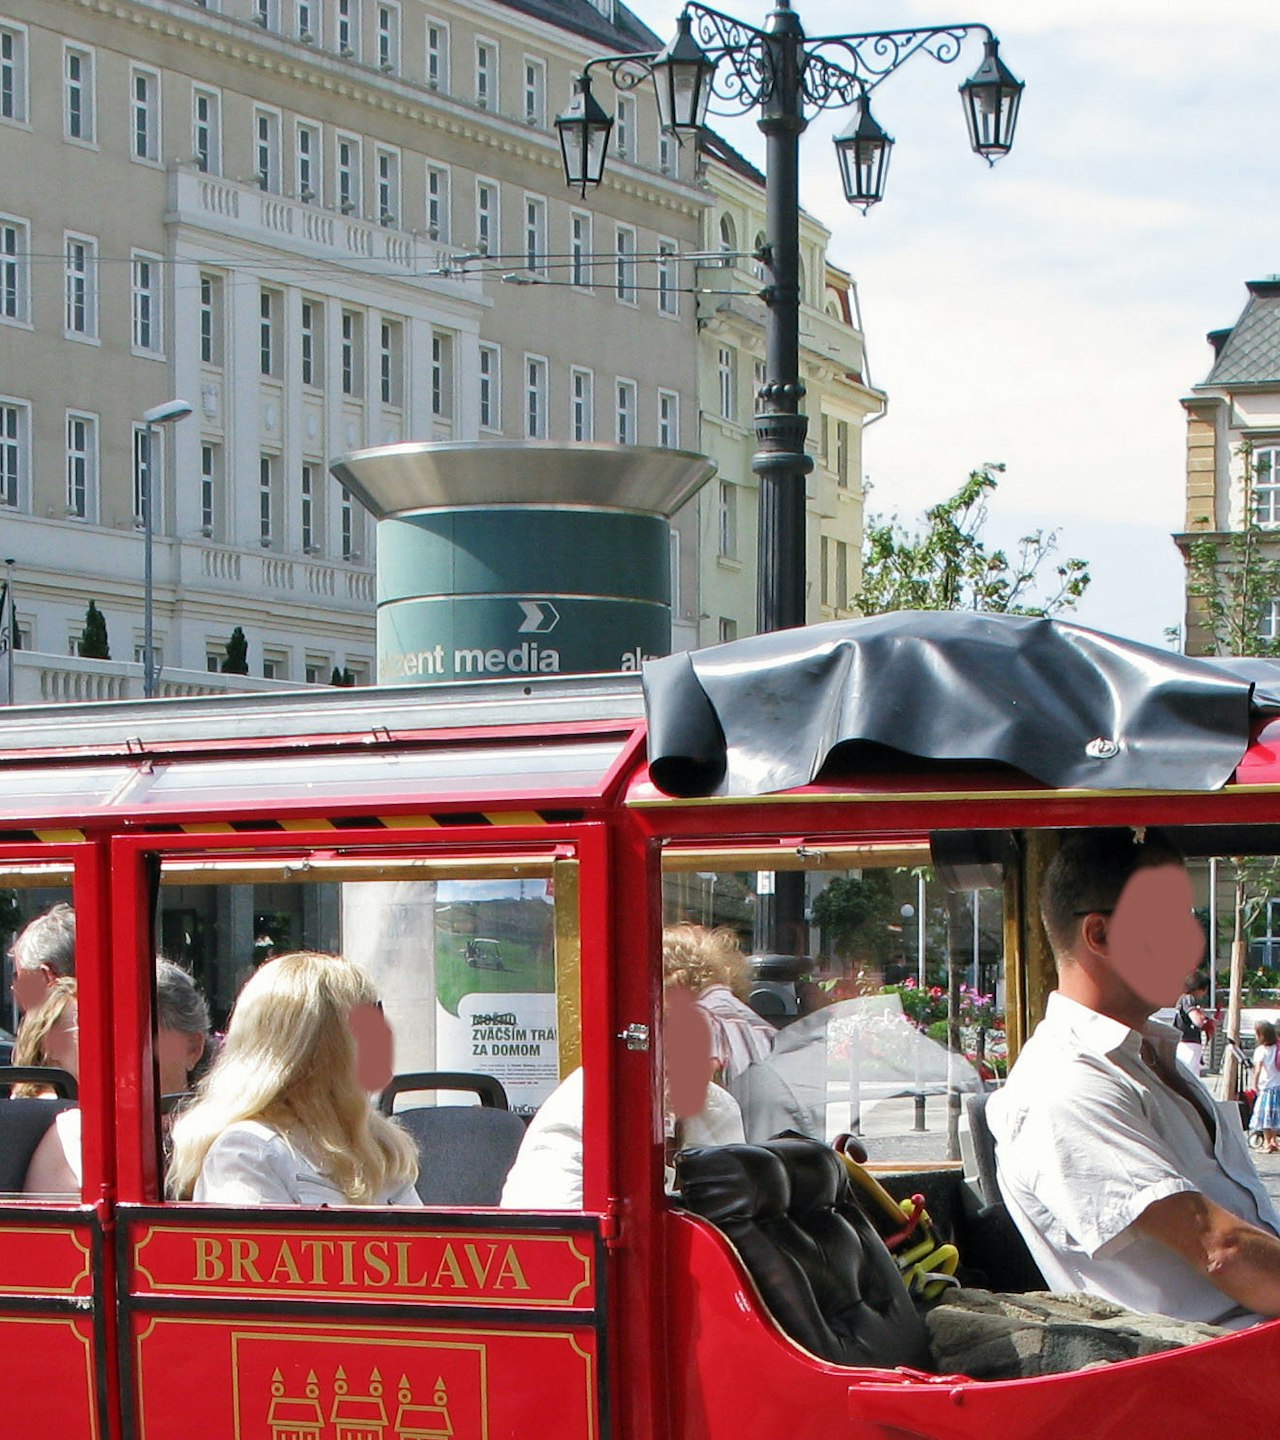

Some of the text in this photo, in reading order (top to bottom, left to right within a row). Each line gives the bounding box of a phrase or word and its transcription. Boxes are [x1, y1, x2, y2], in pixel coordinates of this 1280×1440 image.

[453, 642, 561, 673] media
[472, 1026, 527, 1041] ZVÄČŠÍM
[472, 1044, 541, 1056] ZA DOMOM
[192, 1237, 531, 1291] BRATISLAVA
